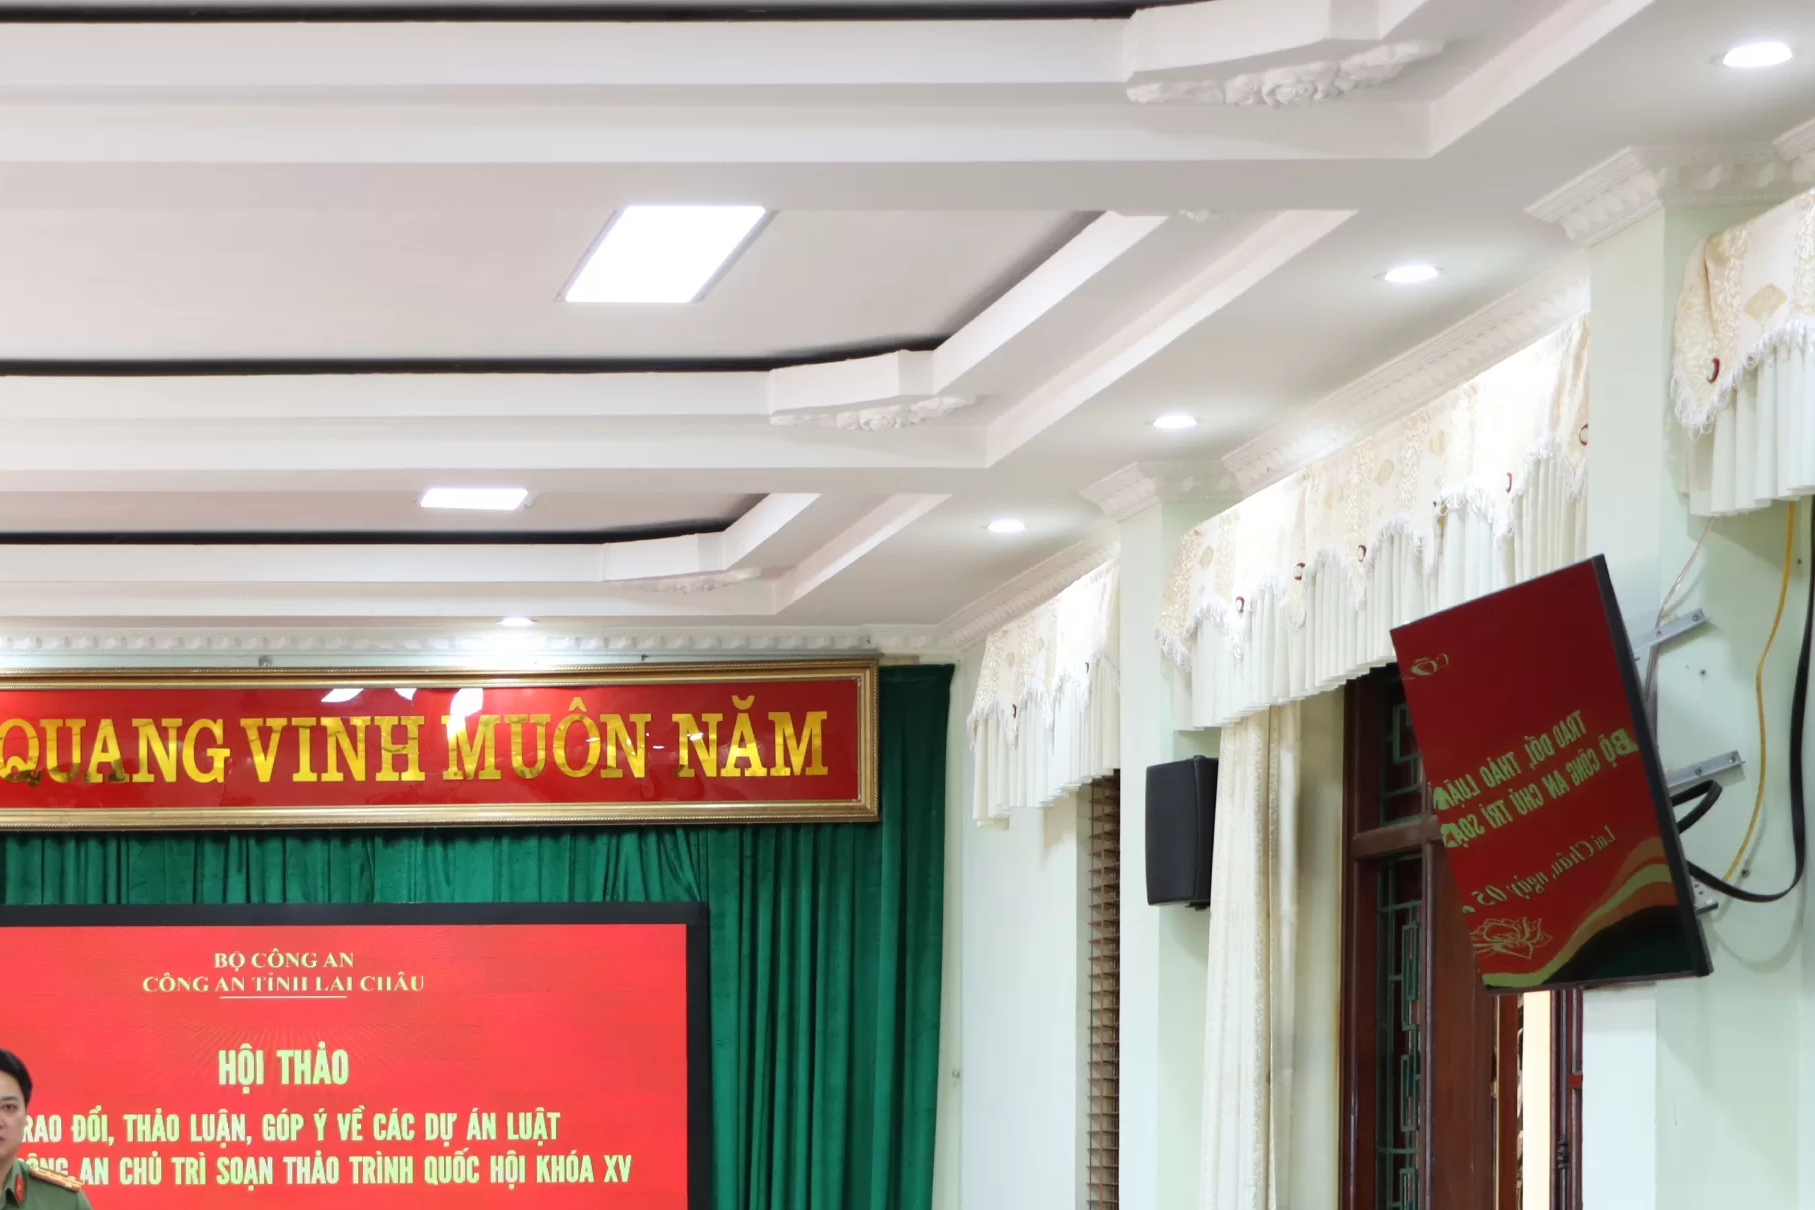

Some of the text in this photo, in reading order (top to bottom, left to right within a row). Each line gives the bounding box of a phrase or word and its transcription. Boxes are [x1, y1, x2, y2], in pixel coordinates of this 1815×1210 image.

[239, 716, 426, 783] VINH
[441, 697, 652, 780] MUÔN
[672, 695, 828, 779] NĂM
[142, 971, 425, 992] CÔNG AN TỈNH LAI CHÂU
[214, 948, 354, 972] BỘ CÔNG AN
[218, 1041, 349, 1094] HỘI THẢO
[22, 1105, 560, 1148] RAO ĐỔI, THẢO LUẬN, GÓP Ý VỀ CÁC DỰ ÁN LUẬT
[79, 1157, 109, 1186] AN
[119, 1151, 162, 1185] CHỦ
[171, 1152, 206, 1185] TRÌ
[216, 1156, 273, 1191] SOẠN
[283, 1150, 339, 1184] THẢO
[349, 1151, 414, 1184] TRÌNH
[424, 1147, 480, 1185] QUỐC
[490, 1150, 525, 1189] HỘI
[536, 1149, 594, 1183] KHÓA
[603, 1154, 632, 1183] XV
